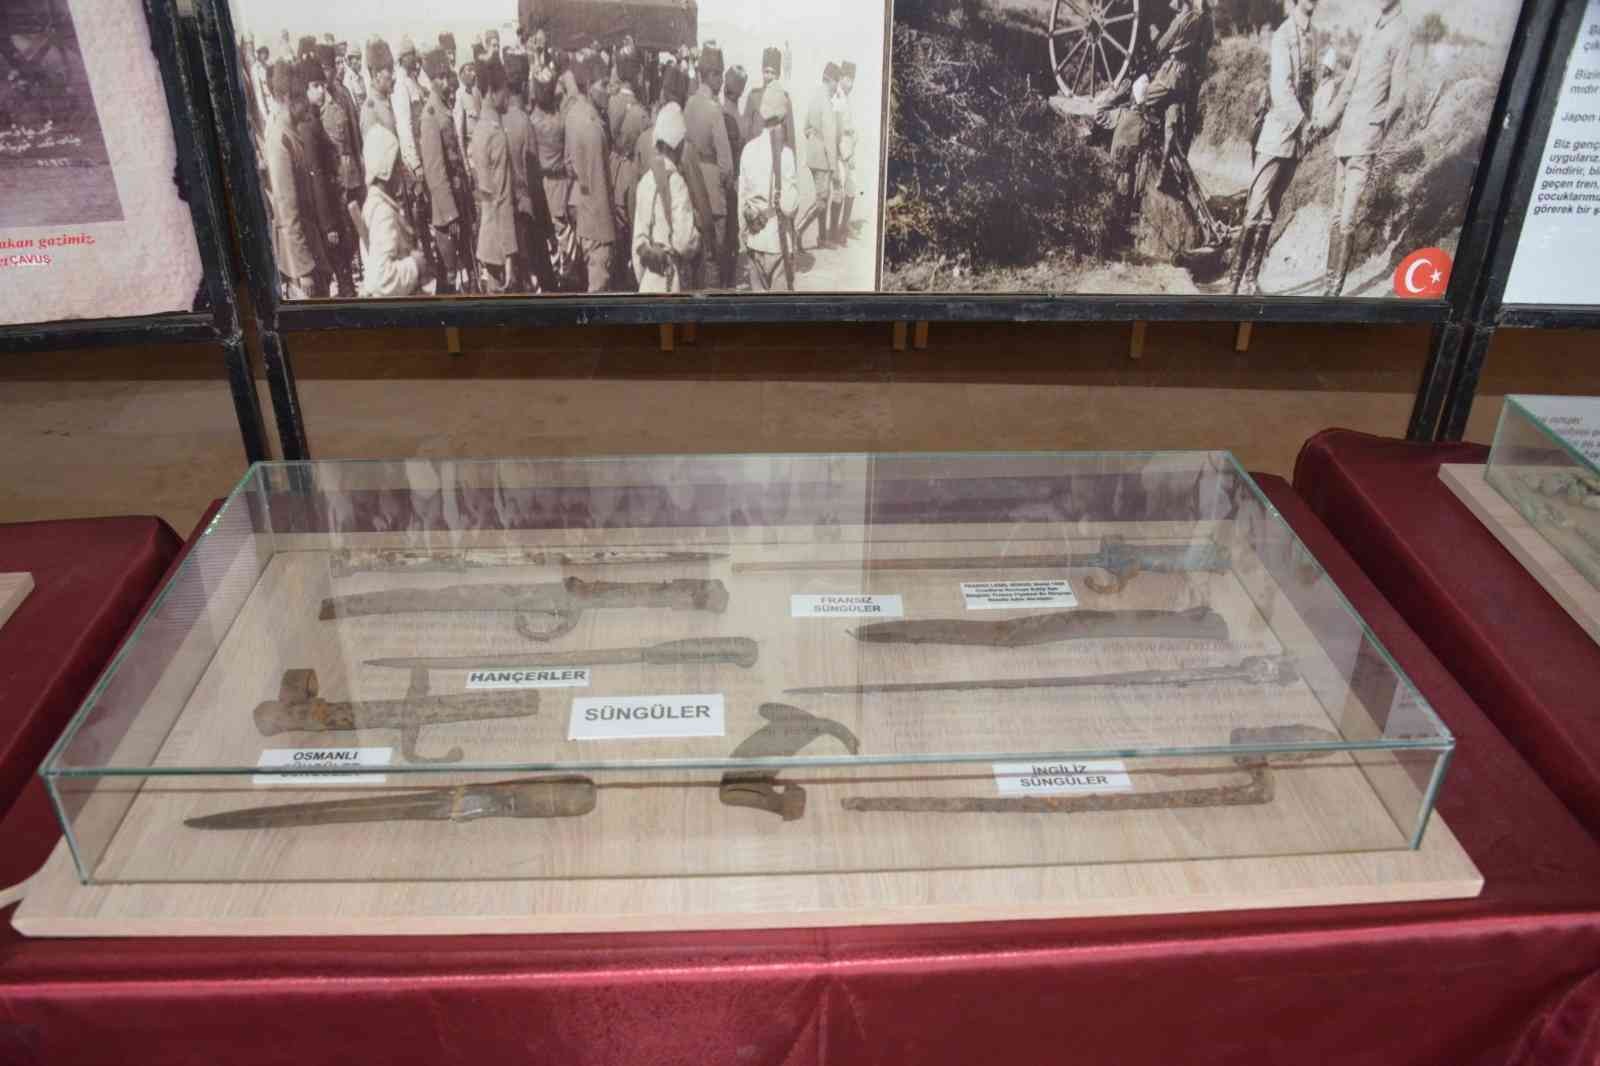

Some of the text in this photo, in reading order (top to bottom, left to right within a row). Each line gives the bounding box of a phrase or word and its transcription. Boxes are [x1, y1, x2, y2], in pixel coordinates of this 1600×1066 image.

[1561, 113, 1595, 123] Japon
[1553, 138, 1571, 149] Biz
[1541, 180, 1573, 190] geçen
[1534, 204, 1573, 215] görerek
[470, 670, 586, 684] HANÇERLER
[584, 704, 711, 722] SÜNGÜLER
[293, 751, 359, 761] OSMANLI
